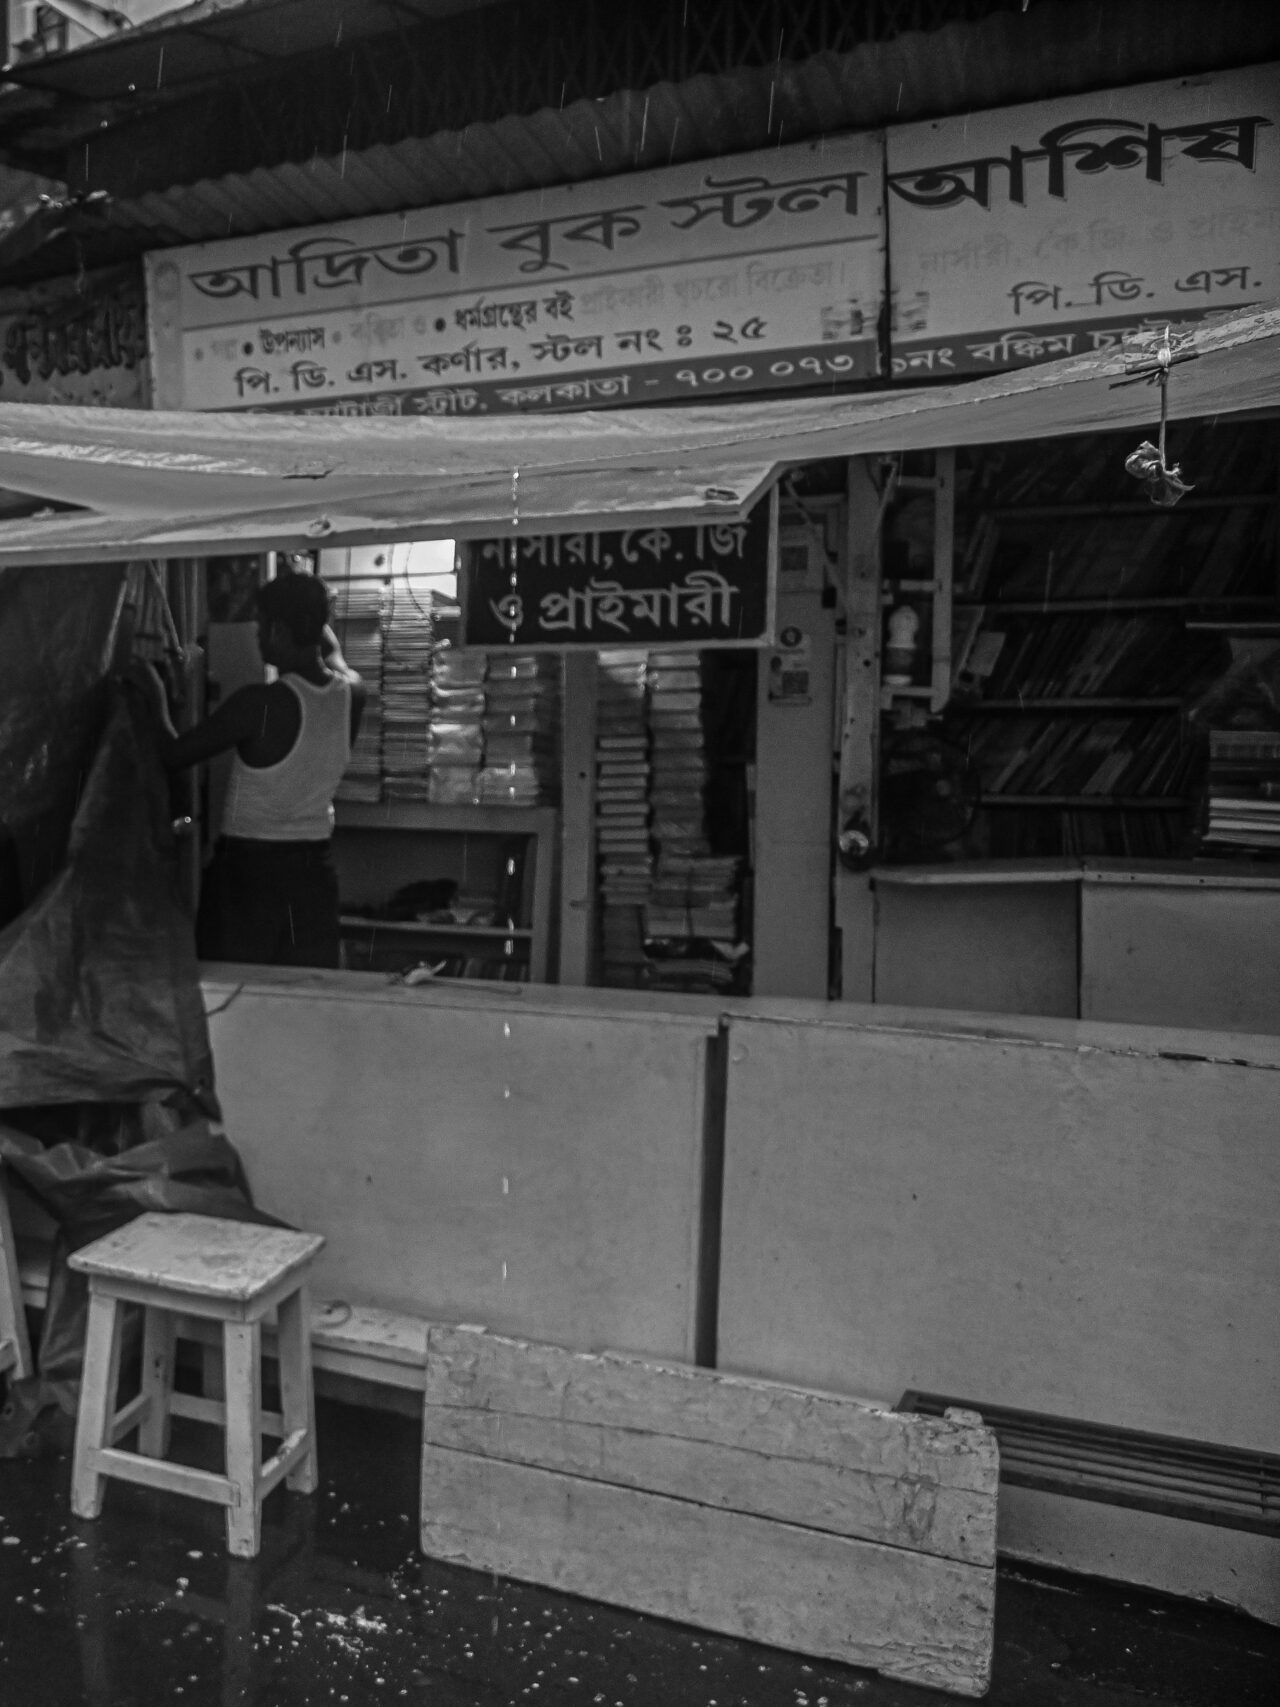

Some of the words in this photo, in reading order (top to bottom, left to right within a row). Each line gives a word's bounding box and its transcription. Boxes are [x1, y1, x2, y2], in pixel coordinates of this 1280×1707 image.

[887, 115, 1274, 212] আশিষ
[188, 228, 465, 299] আদ্রিতা
[485, 204, 647, 273] বুক
[658, 172, 869, 229] স্টল
[259, 326, 326, 355] উপন্যাস
[454, 296, 538, 331] ধর্মগ্রন্থের
[542, 289, 575, 322] বই
[1007, 280, 1073, 316] পি.
[1088, 270, 1156, 306] ডি.
[1174, 265, 1264, 295] এস.
[234, 366, 280, 397] পি.
[290, 360, 335, 391] ডি.
[347, 358, 408, 383] এস.
[529, 334, 605, 363] স্টল
[613, 327, 663, 355] নং
[711, 315, 768, 348] ২৫
[965, 330, 1077, 363] বঙ্কিম
[493, 374, 633, 406] কলকাতা
[675, 364, 754, 388] ৭০০
[770, 353, 854, 377] ০৭৩
[488, 593, 524, 629] ও
[537, 570, 741, 634] প্রাইমারী
